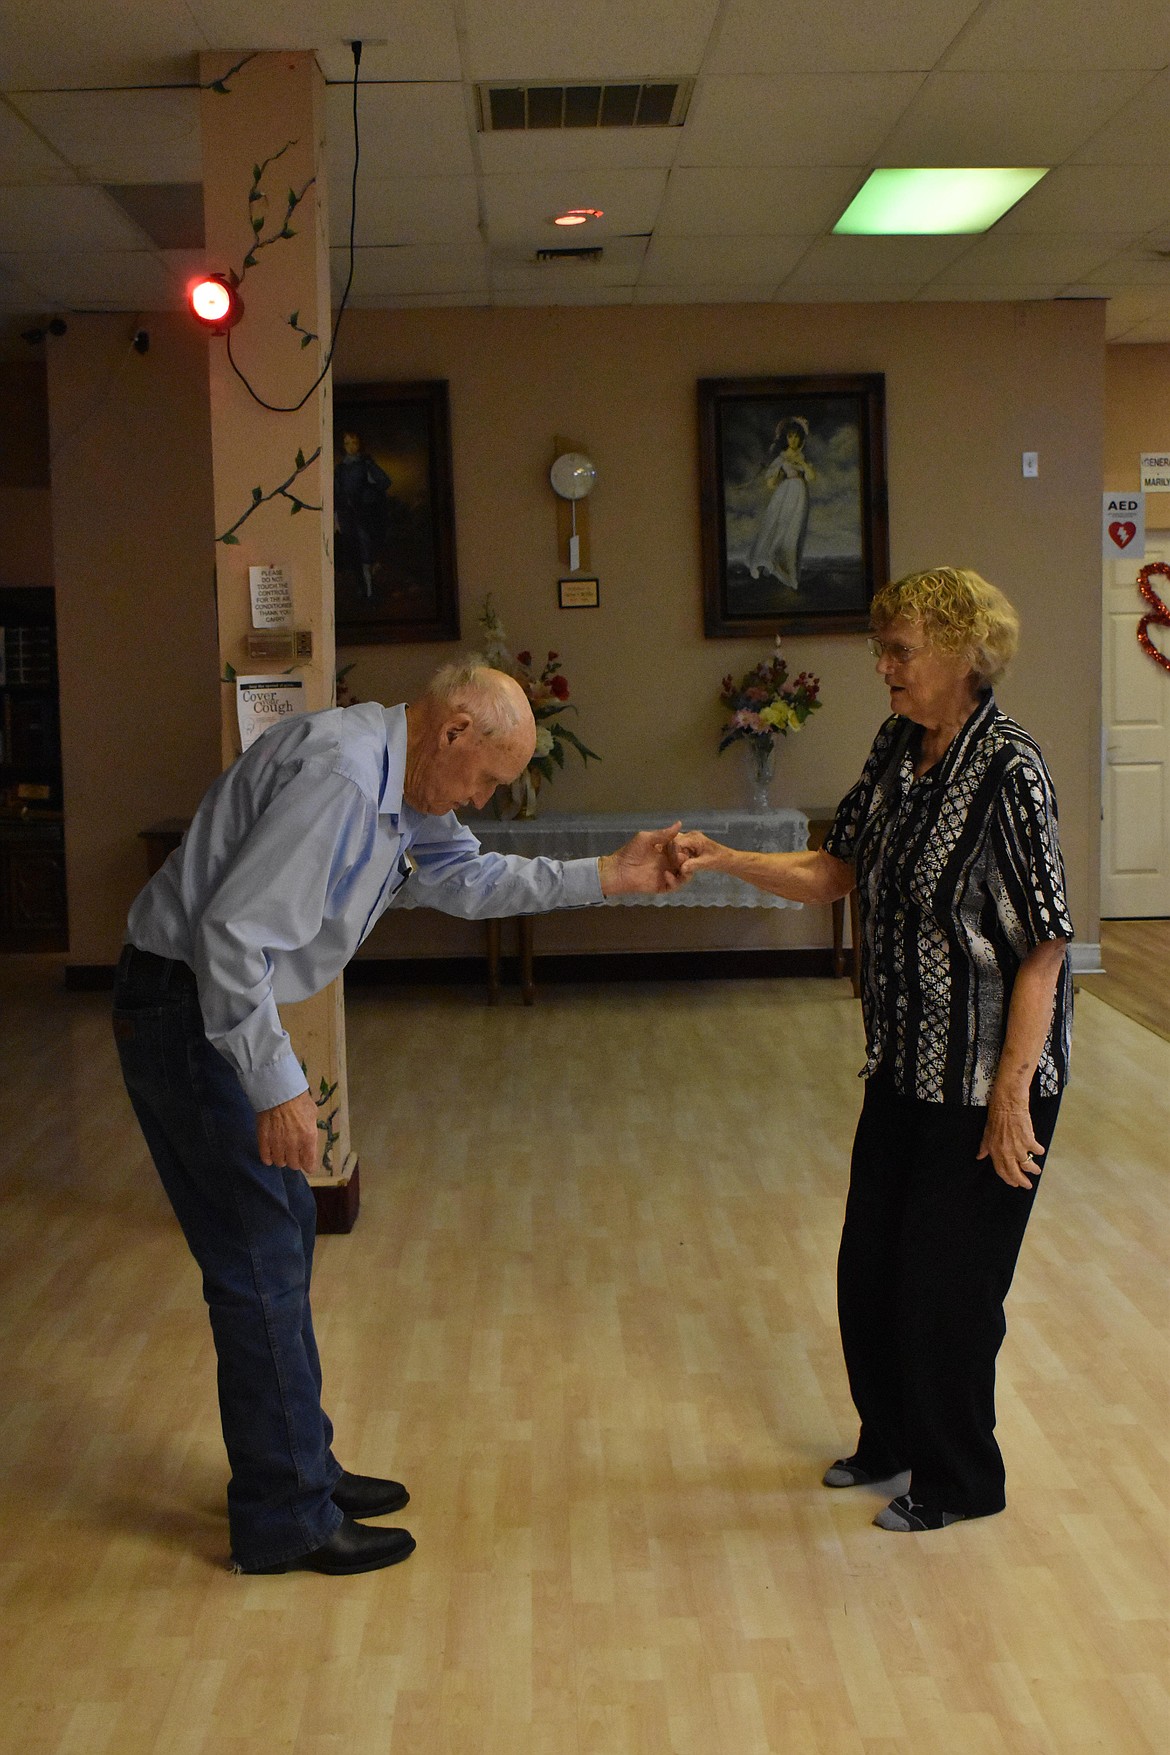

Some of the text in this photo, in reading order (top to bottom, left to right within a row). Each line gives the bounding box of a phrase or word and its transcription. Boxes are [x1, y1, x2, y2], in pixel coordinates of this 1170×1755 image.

[1143, 458, 1170, 466] GENER
[1108, 501, 1138, 510] AED
[243, 691, 277, 702] Cover
[253, 700, 293, 715] Cough
